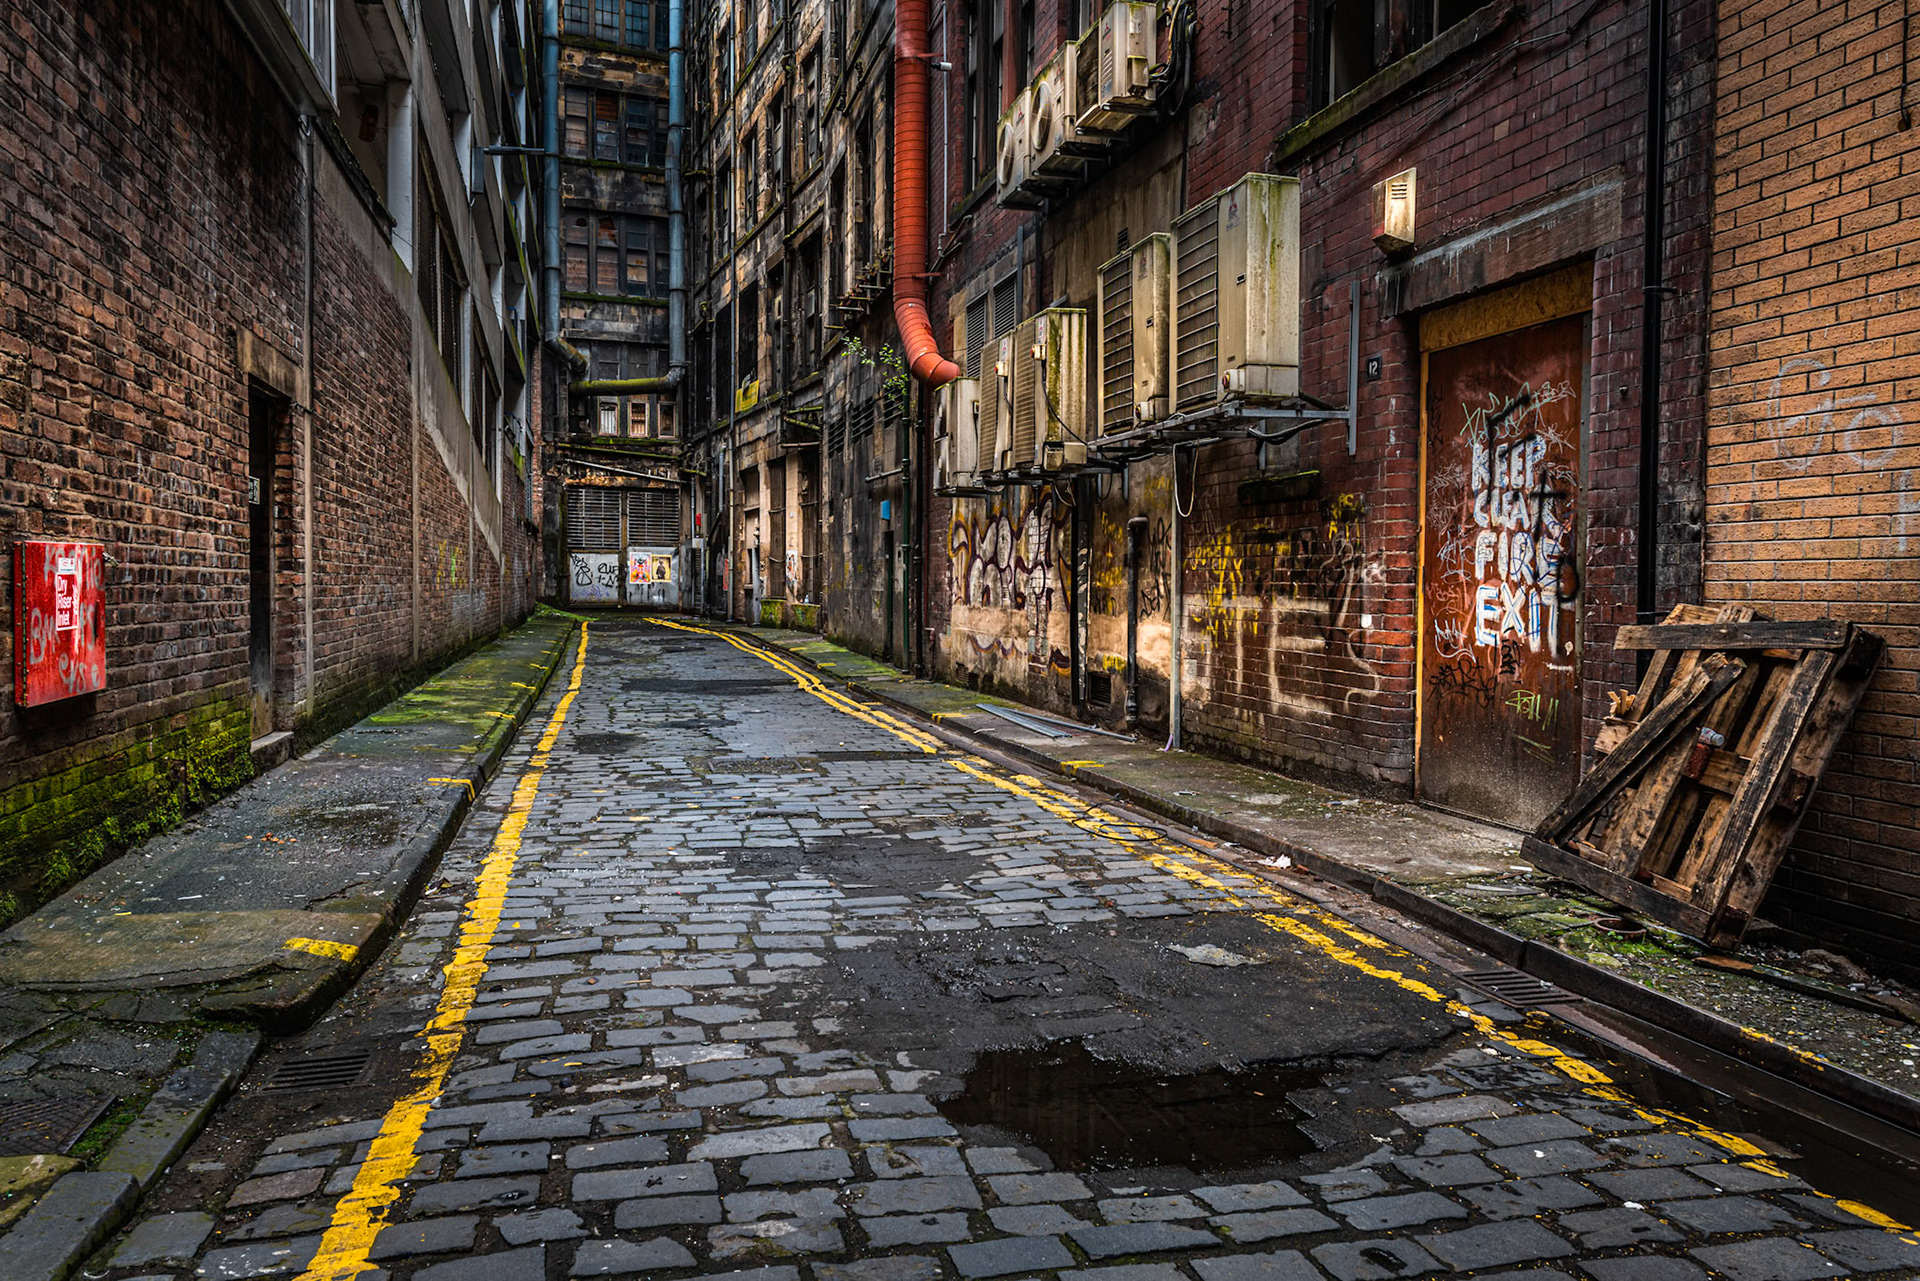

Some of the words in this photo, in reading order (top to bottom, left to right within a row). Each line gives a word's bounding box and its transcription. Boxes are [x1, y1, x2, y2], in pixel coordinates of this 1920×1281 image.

[1368, 360, 1378, 376] 12
[1471, 434, 1548, 492] KEEP
[1474, 483, 1562, 539] CLEAR
[1474, 529, 1564, 591] FIRE
[57, 575, 68, 596] Dry
[57, 593, 72, 609] Riser
[57, 610, 70, 626] Inlet
[1475, 580, 1575, 658] EXIT
